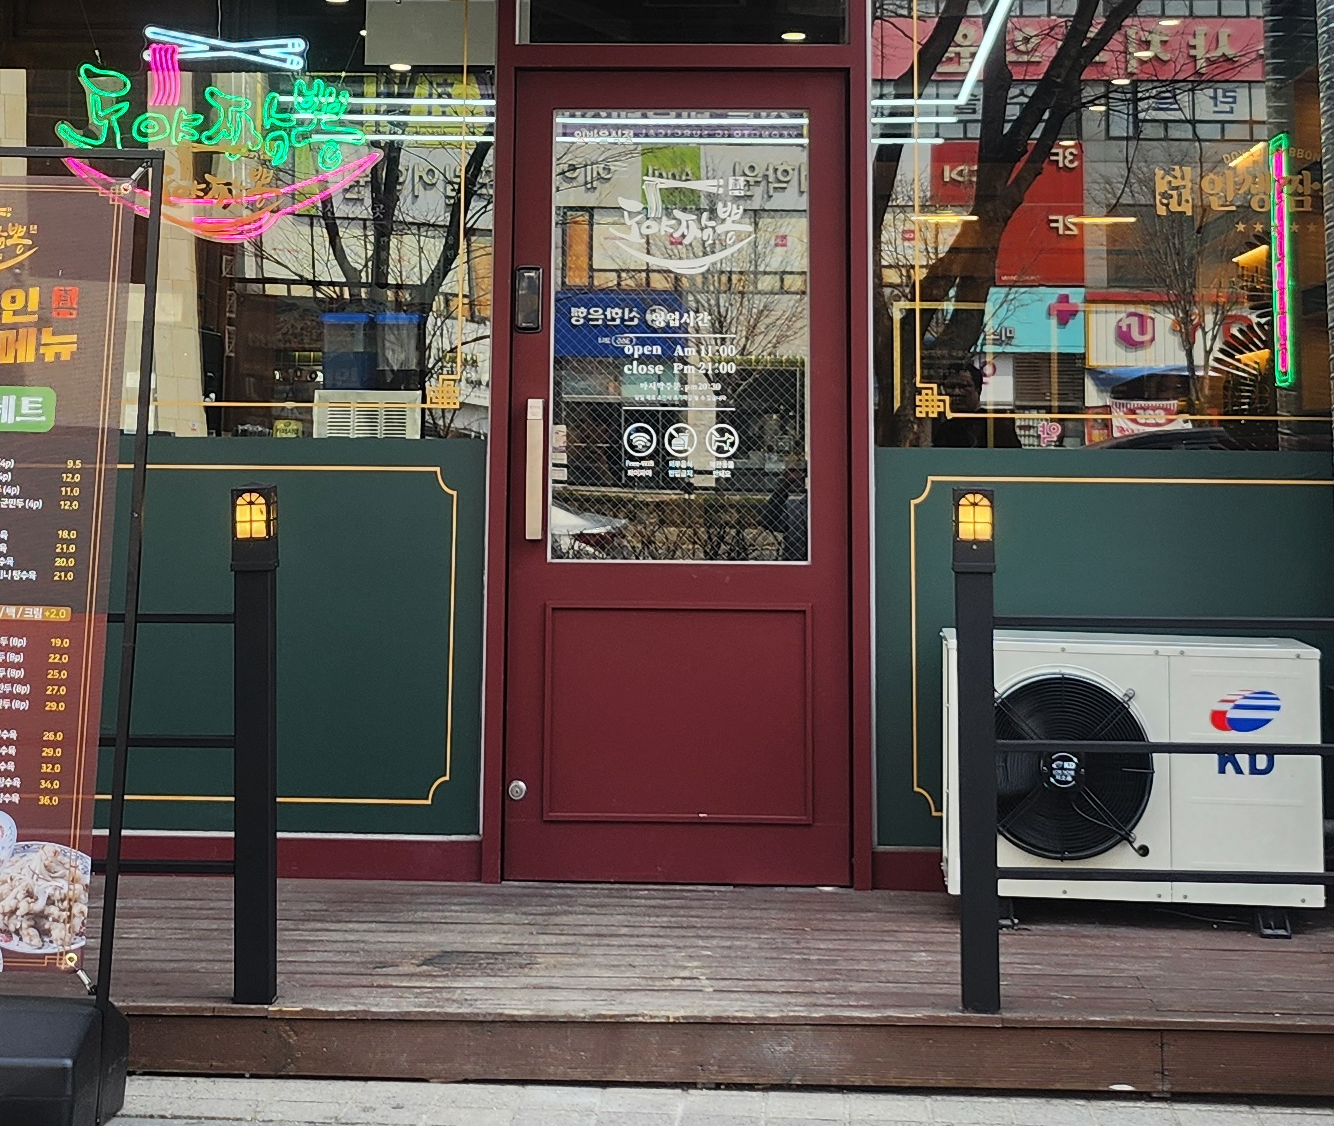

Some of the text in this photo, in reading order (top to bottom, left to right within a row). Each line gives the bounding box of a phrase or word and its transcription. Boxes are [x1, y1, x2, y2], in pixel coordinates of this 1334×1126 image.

[623, 344, 662, 358] open
[623, 360, 665, 375] close
[698, 362, 736, 375] 21:00
[67, 459, 82, 469] 9.5
[61, 473, 81, 482] 12.0
[60, 487, 80, 496] 11.0
[59, 500, 79, 510] 12.0
[57, 529, 77, 539] 18.0
[55, 543, 76, 553] 21.0
[54, 557, 75, 567] 20.0
[53, 571, 74, 580] 21.0
[50, 638, 70, 647] 19.0
[48, 654, 69, 663] 22.0
[47, 669, 68, 679] 25.0
[46, 686, 67, 695] 27.0
[44, 701, 66, 711] 29.0
